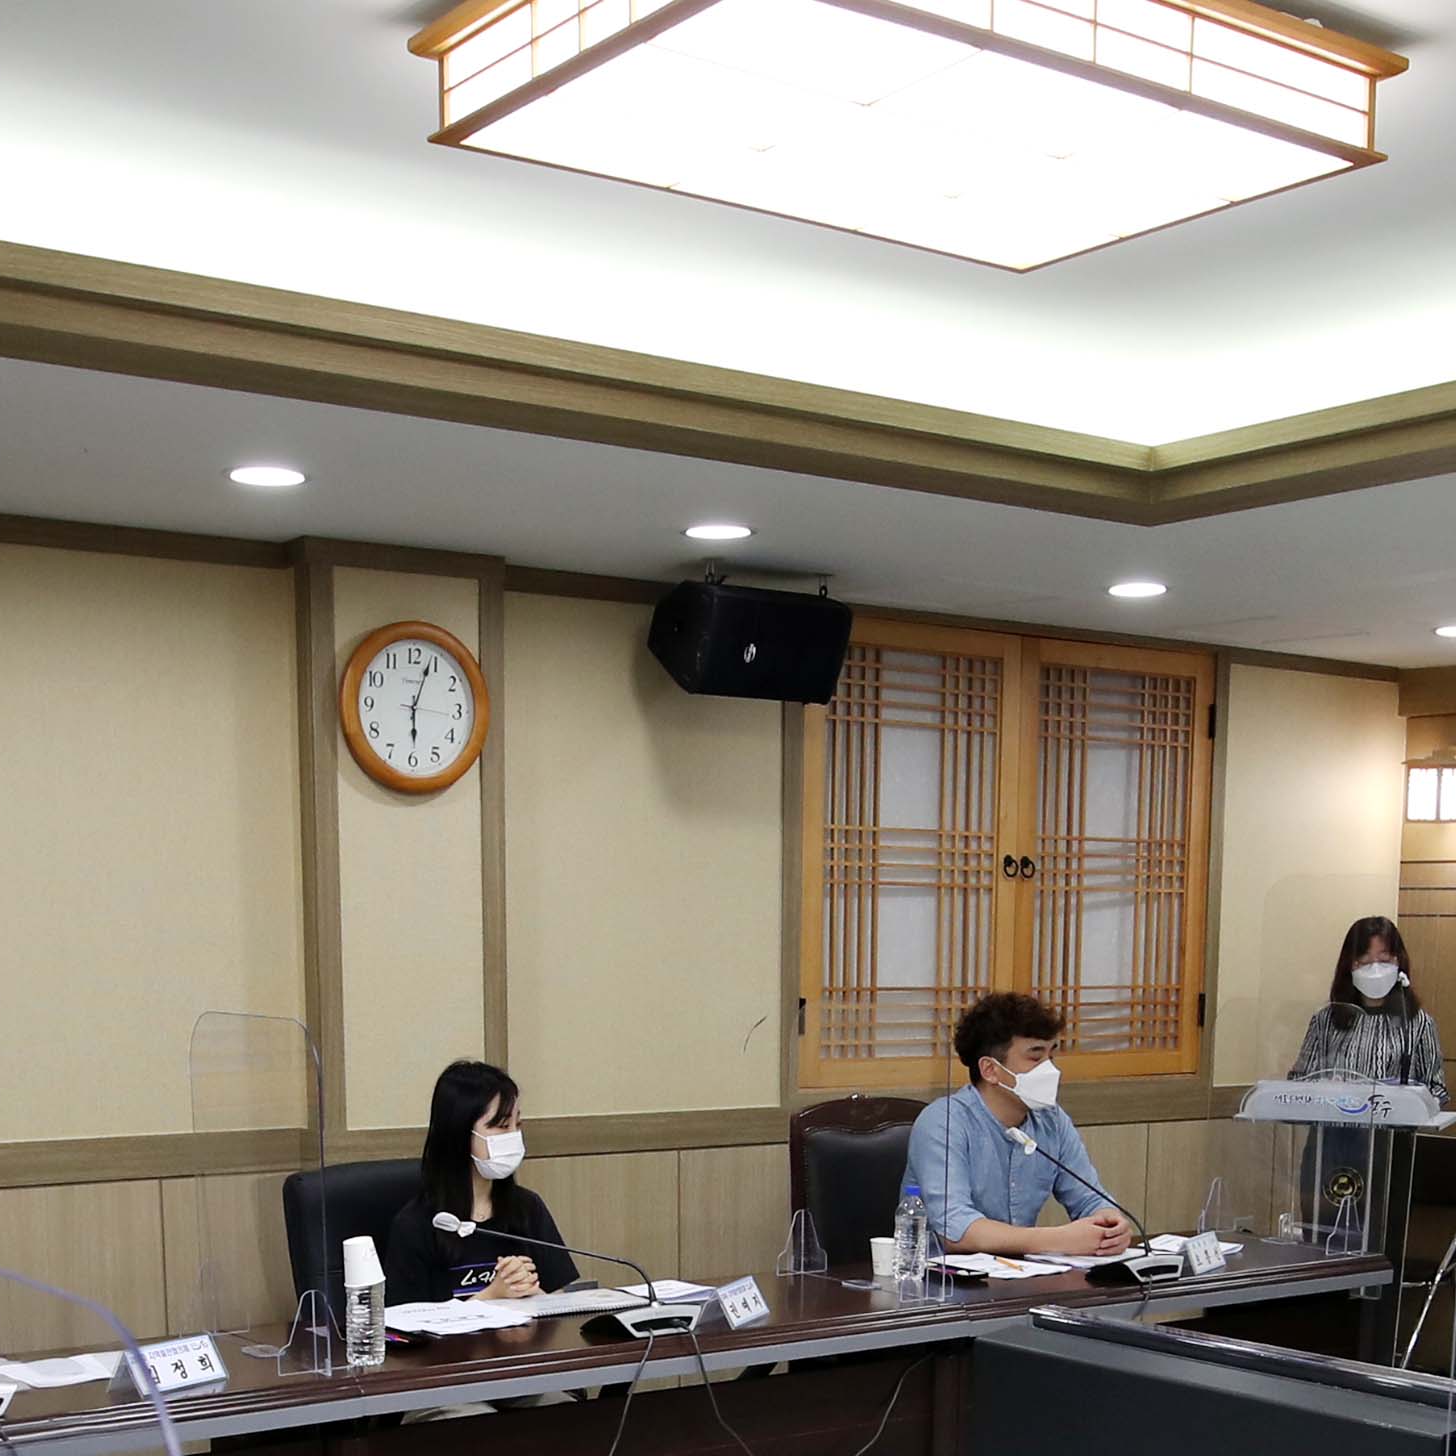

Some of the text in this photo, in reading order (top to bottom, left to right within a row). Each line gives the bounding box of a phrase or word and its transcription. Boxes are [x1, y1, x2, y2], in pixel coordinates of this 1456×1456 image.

[386, 653, 396, 669] 11
[408, 648, 421, 664] 12
[433, 656, 438, 672] 1
[368, 671, 383, 687] 10
[448, 676, 456, 692] 2
[364, 696, 374, 712] 9
[452, 703, 462, 720] 3
[369, 721, 379, 738] 8
[444, 728, 454, 743] 4
[386, 743, 394, 759] 7
[408, 751, 418, 767] 6
[430, 747, 440, 762] 5
